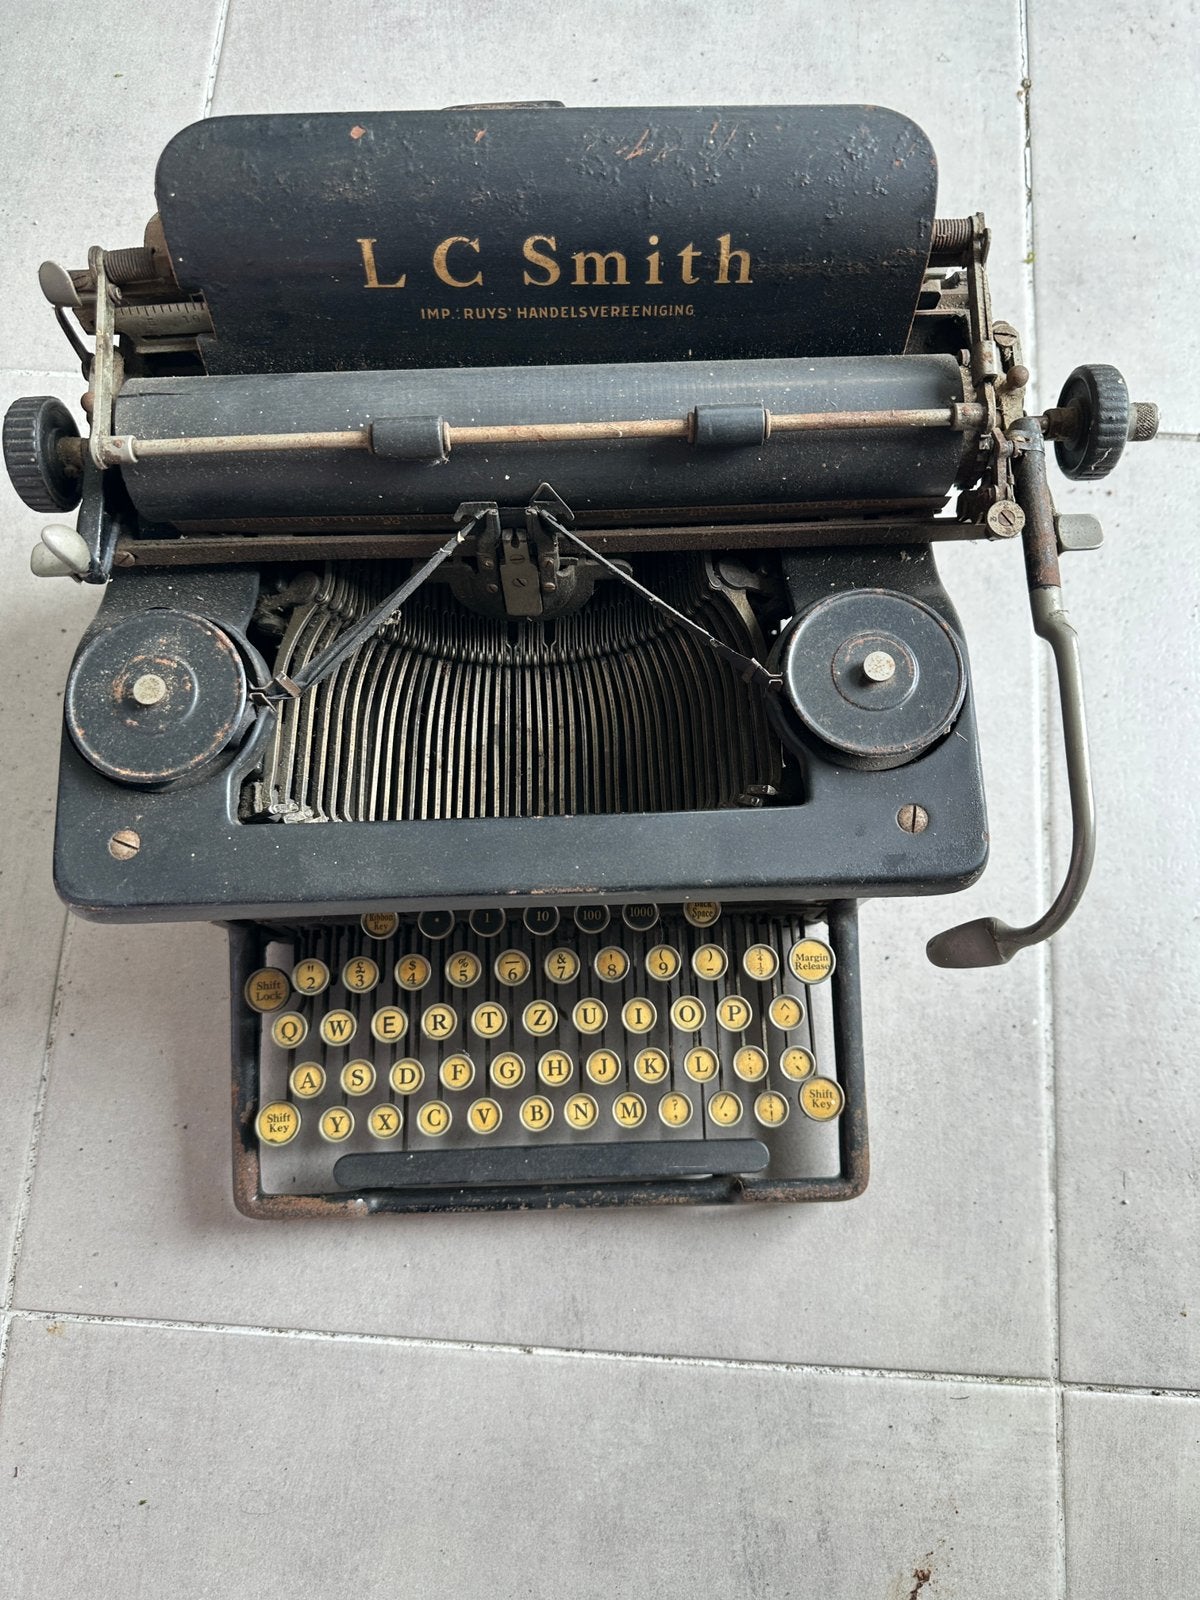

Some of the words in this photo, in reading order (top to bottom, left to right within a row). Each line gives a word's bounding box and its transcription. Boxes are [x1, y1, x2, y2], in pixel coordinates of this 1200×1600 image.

[357, 238, 406, 288] L
[433, 236, 483, 287] C
[523, 233, 753, 286] Smith
[517, 304, 695, 319] HANDELSVEREENIGING
[536, 911, 549, 921] 10
[582, 911, 601, 920] 100
[630, 907, 653, 917] 1000
[692, 907, 713, 919] Space
[408, 960, 417, 971] $
[556, 953, 567, 964] &
[795, 953, 829, 964] Margin
[795, 962, 830, 971] Release
[306, 977, 316, 990] 2
[354, 974, 364, 987] 3
[406, 972, 417, 985] 4
[459, 969, 468, 983] 5
[508, 968, 518, 981] 6
[557, 966, 567, 979] 7
[607, 963, 617, 977] 8
[658, 962, 669, 975] 9
[256, 981, 281, 991] Shift
[255, 991, 282, 1002] Lock
[281, 1021, 299, 1041] Q
[328, 1019, 350, 1037] W
[383, 1016, 396, 1034] E
[431, 1013, 448, 1031] R
[480, 1011, 498, 1029] T
[533, 1009, 547, 1026] Z
[581, 1007, 597, 1025] U
[634, 1007, 643, 1025] I
[679, 1005, 696, 1023] O
[727, 1004, 742, 1022] P
[300, 1071, 317, 1090] A
[351, 1069, 364, 1087] S
[399, 1067, 416, 1085] D
[451, 1063, 466, 1081] F
[500, 1061, 516, 1079] G
[547, 1059, 564, 1077] H
[598, 1058, 608, 1076] J
[643, 1057, 660, 1075] K
[695, 1056, 708, 1073] L
[809, 1089, 833, 1099] Shift
[812, 1098, 832, 1109] Key
[266, 1112, 291, 1124] Shift
[329, 1116, 345, 1133] Y
[377, 1113, 393, 1131] X
[427, 1108, 442, 1127] C
[476, 1108, 492, 1125] V
[530, 1104, 544, 1121] B
[573, 1102, 588, 1120] N
[620, 1101, 639, 1119] M
[269, 1123, 289, 1134] Key
